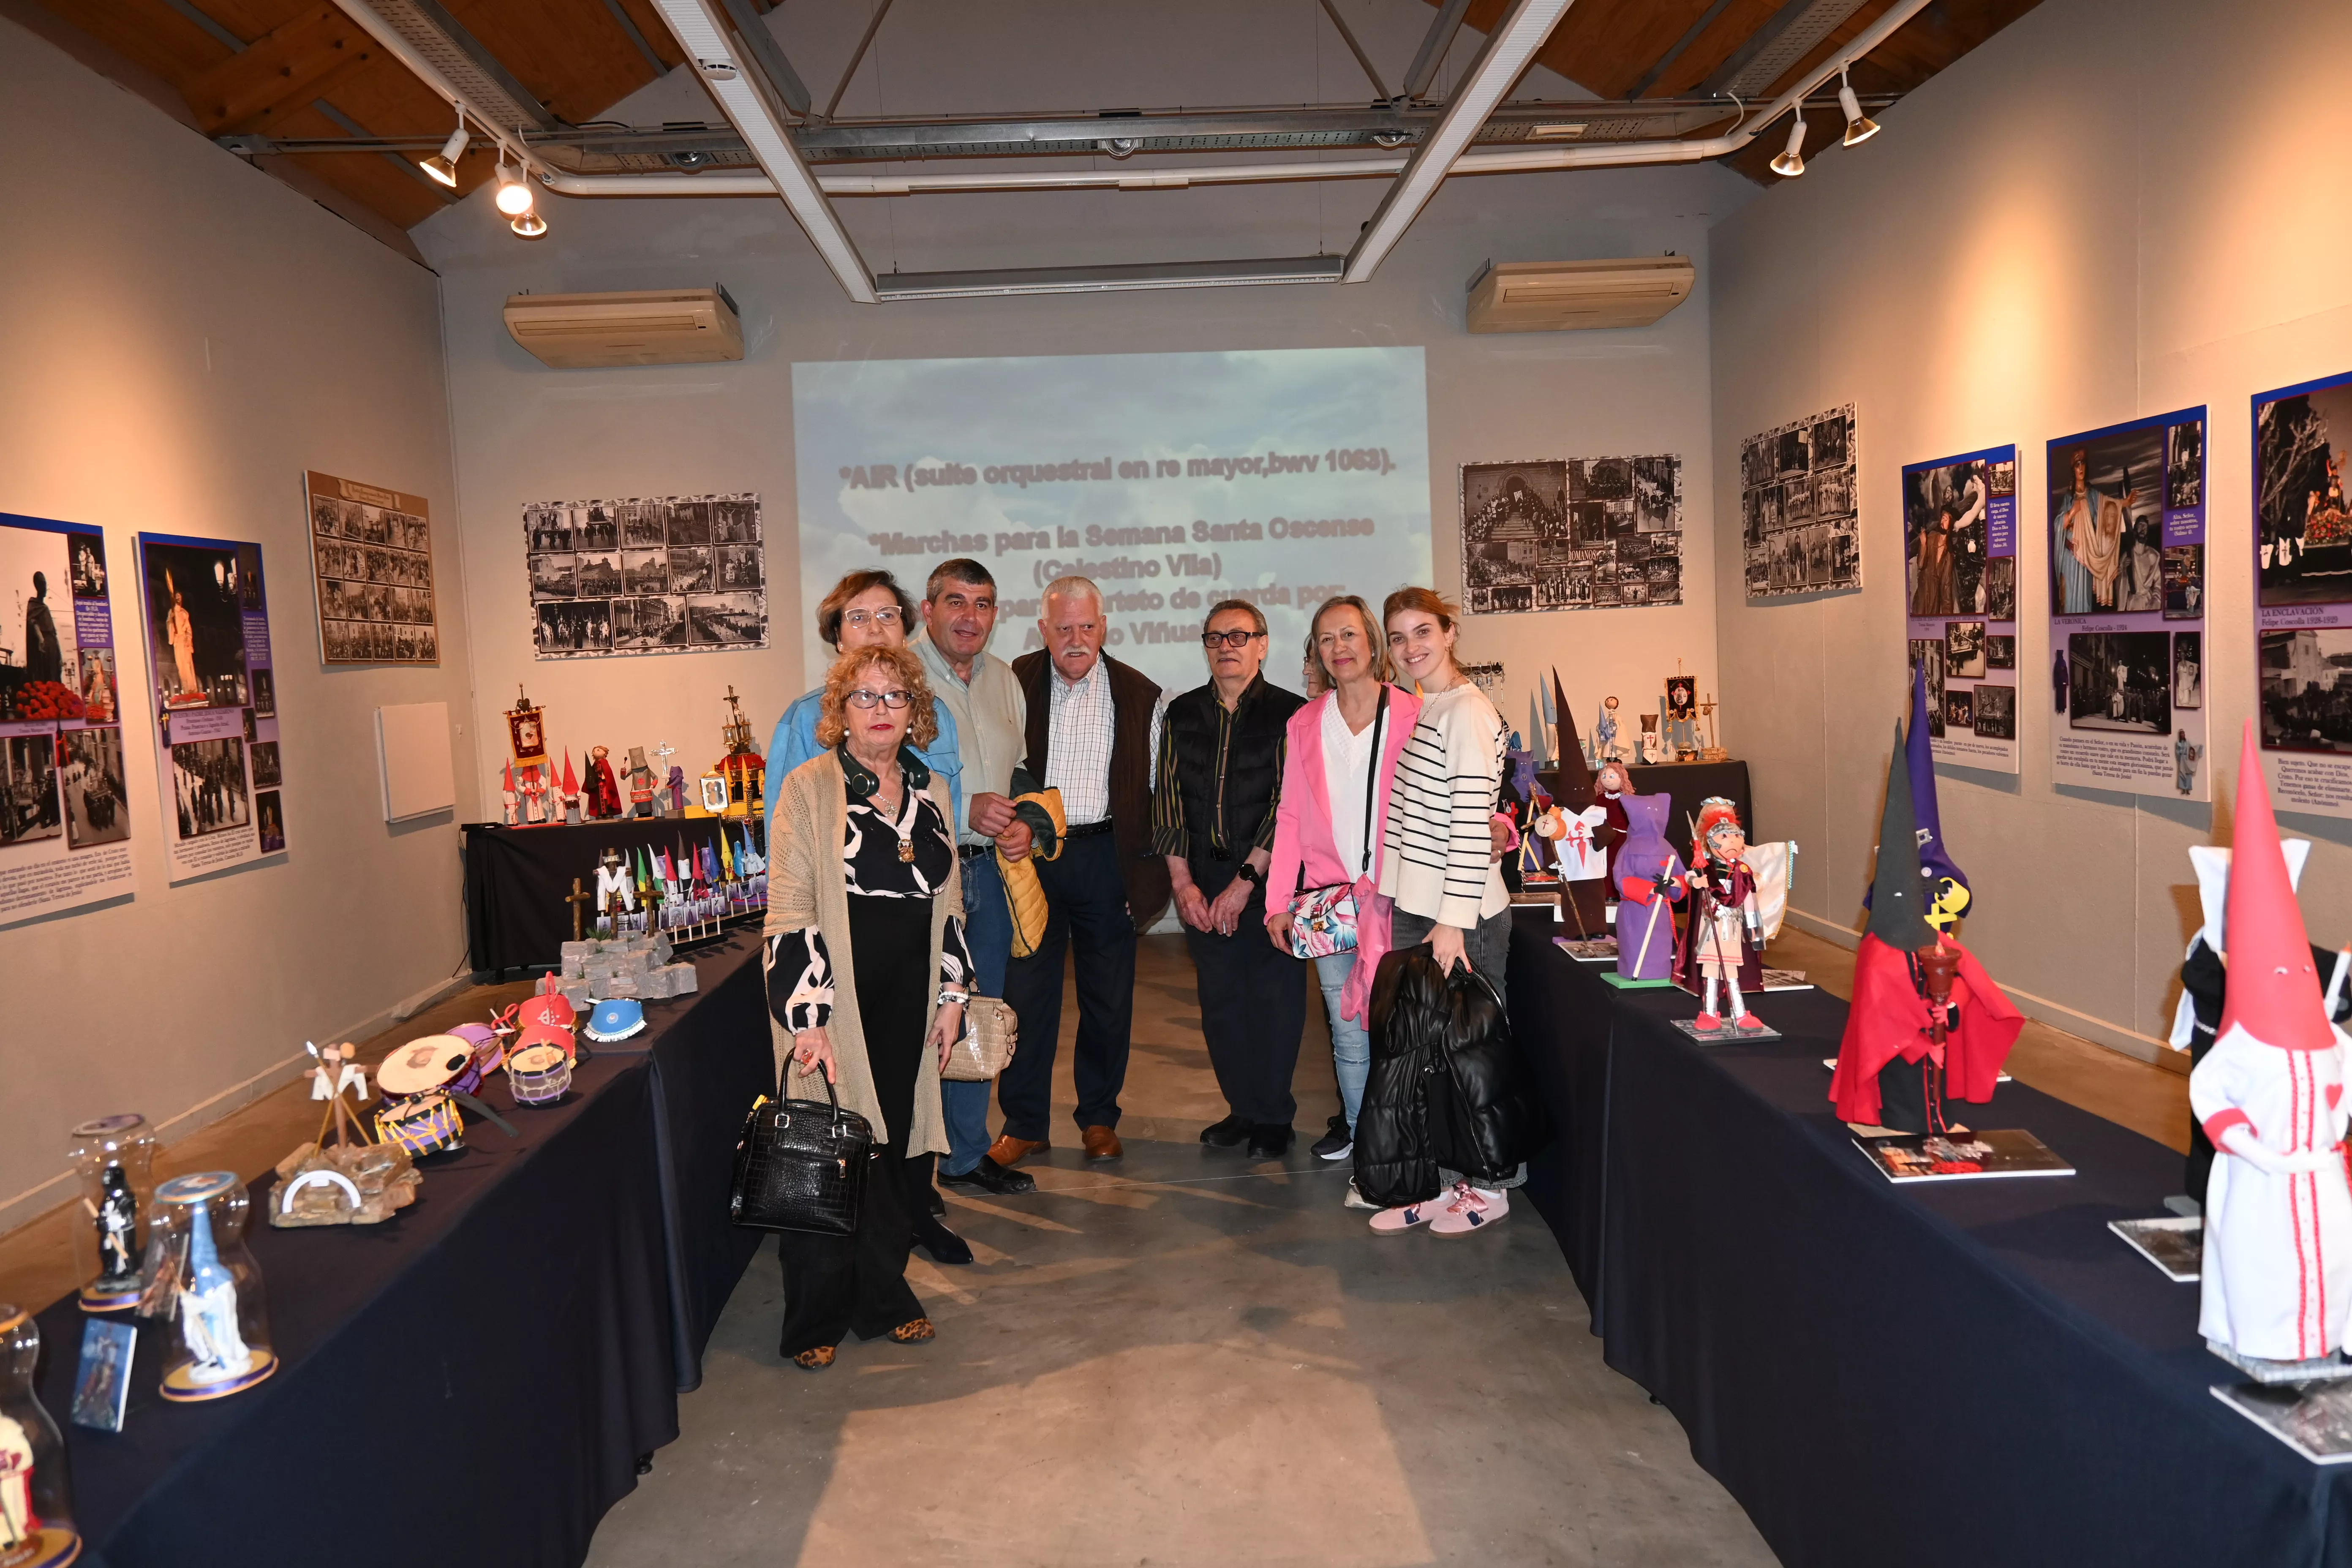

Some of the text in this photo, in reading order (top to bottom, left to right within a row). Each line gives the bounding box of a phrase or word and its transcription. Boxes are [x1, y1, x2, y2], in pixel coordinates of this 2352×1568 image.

[904, 463, 977, 493] (suite
[983, 457, 1112, 488] orquestral
[1118, 460, 1149, 479] en
[1156, 460, 1181, 477] re
[994, 531, 1051, 556] para
[1057, 525, 1079, 547] la
[1085, 524, 1186, 546] Semana
[1192, 519, 1263, 542] Santa
[1268, 517, 1375, 539] Oscense
[1568, 550, 1596, 561] ROMANOS
[1033, 556, 1161, 588] (Celestino
[1170, 587, 1201, 610] de
[1297, 585, 1346, 609] por
[2273, 607, 2324, 616] ENCLAVACIÓN
[2262, 618, 2278, 626] Felipe
[2307, 616, 2338, 624] 1928-1929
[2277, 787, 2307, 797] Reconócelo,
[2311, 799, 2340, 807] (Anónimo).
